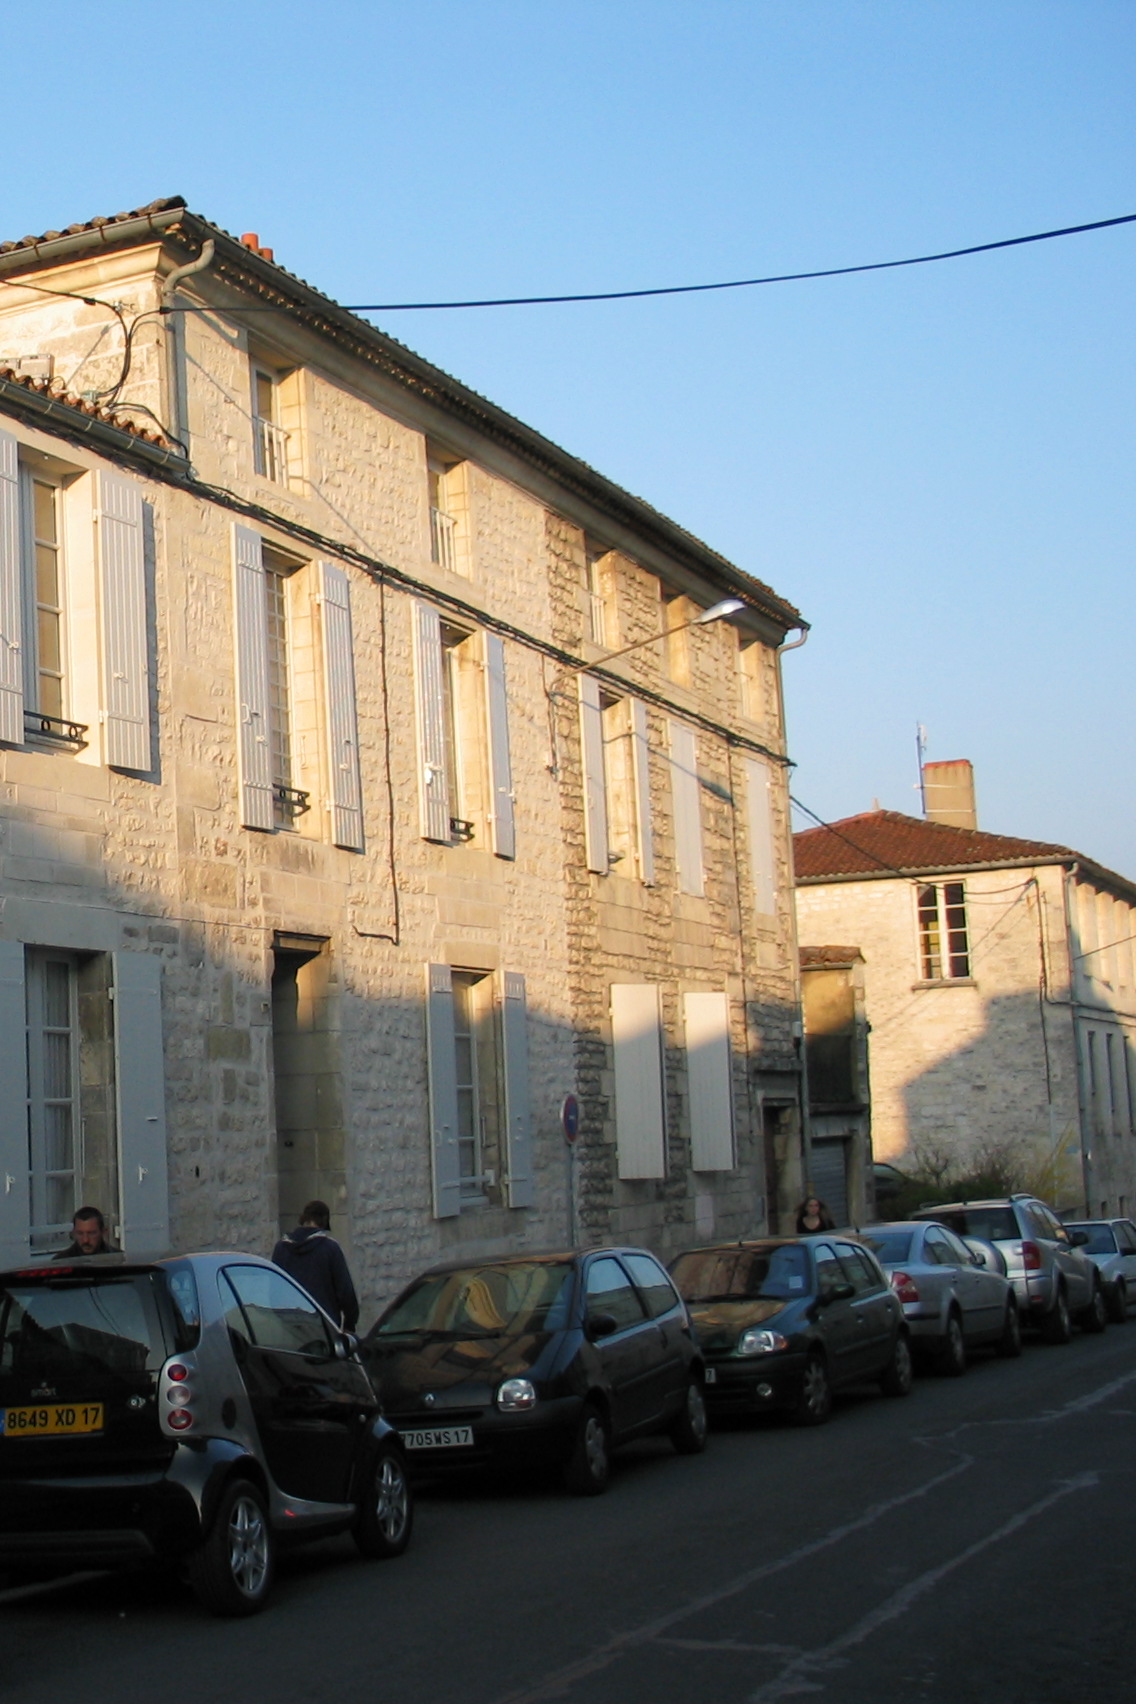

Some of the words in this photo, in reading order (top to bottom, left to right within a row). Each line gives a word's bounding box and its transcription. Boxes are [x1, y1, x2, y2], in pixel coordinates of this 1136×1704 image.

[7, 1409, 48, 1429] 8649
[55, 1408, 76, 1426] XD
[82, 1407, 100, 1425] 17
